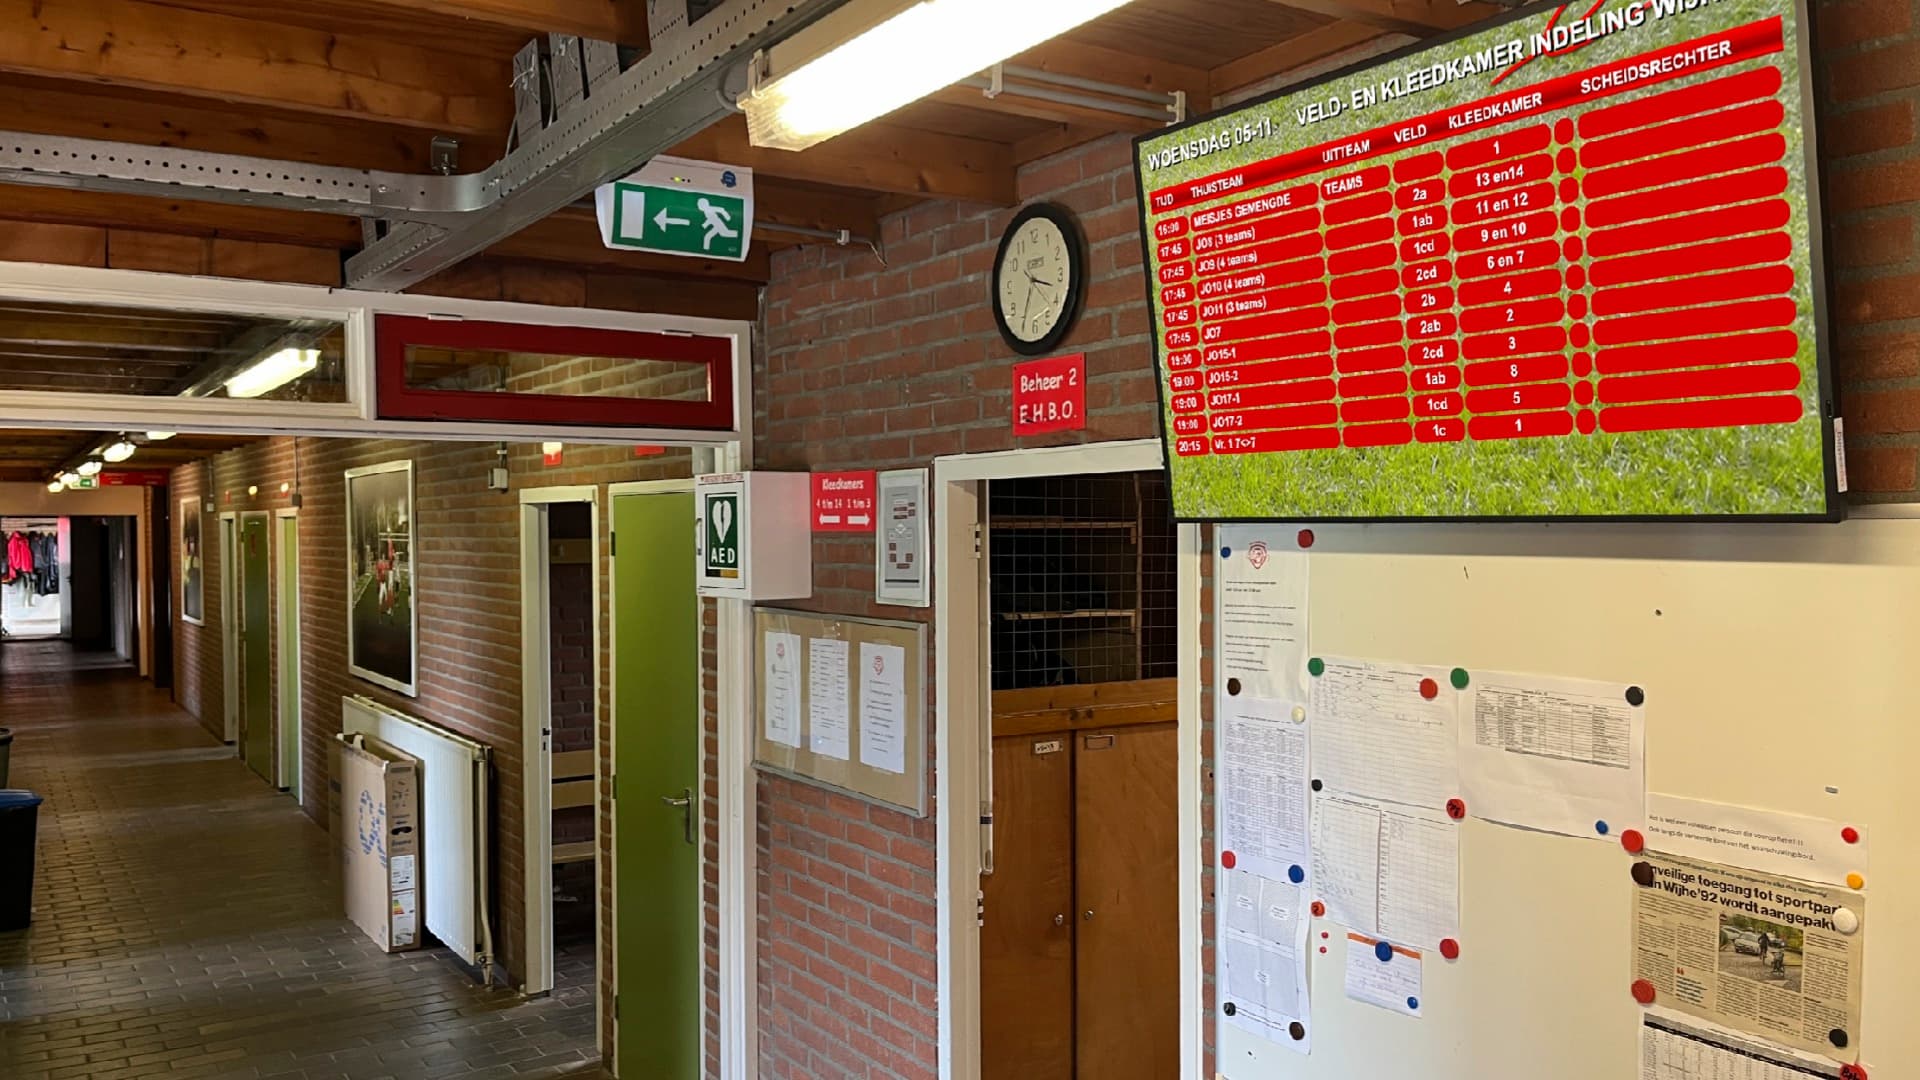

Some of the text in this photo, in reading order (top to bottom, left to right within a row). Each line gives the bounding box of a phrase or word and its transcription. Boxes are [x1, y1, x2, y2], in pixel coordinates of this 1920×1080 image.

[1580, 40, 1733, 94] SCHEIDSRECHTER
[1148, 131, 1231, 170] WOENSDAG
[1296, 97, 1349, 126] VELD-
[1351, 87, 1377, 111] EN
[1381, 39, 1524, 101] KLEEDKAMER
[1530, 3, 1646, 57] INDELING
[1448, 92, 1543, 129] KLEEDKAMER
[1393, 124, 1427, 143] VELD
[1321, 139, 1371, 164] UITTEAM
[1493, 141, 1500, 155] 1
[1190, 174, 1244, 198] THUISTEAM
[1324, 175, 1363, 195] TEAMS
[1476, 172, 1490, 187] 13
[1413, 188, 1427, 201] 2a
[1194, 193, 1291, 227] MEISJES GEMENGDE
[1475, 192, 1529, 215] 11 en 12
[1412, 213, 1433, 228] 1ab
[1030, 228, 1039, 243] 12
[1045, 233, 1050, 246] 1
[1225, 226, 1255, 243] teams)
[1481, 222, 1527, 242] 9 en 10
[1017, 240, 1025, 254] 11
[1055, 246, 1061, 261] 2
[1414, 239, 1435, 255] 1cd
[1227, 250, 1258, 265] teams)
[1487, 250, 1525, 269] 6 en 7
[1058, 267, 1063, 282] 3
[1416, 265, 1437, 282] 2cd
[1200, 280, 1222, 295] JO10
[1234, 272, 1265, 288] teams)
[1504, 281, 1512, 294] 4
[1202, 303, 1223, 318] JO11
[1235, 295, 1267, 312] teams)
[1421, 294, 1436, 307] 2b
[1506, 308, 1515, 322] 2
[1032, 320, 1038, 334] 6
[1204, 326, 1222, 340] JO7
[1420, 320, 1441, 334] 2ab
[1508, 336, 1516, 350] 3
[1206, 347, 1237, 361] JO15-1
[1423, 345, 1444, 359] 2cd
[1208, 370, 1239, 384] JO15-2
[1510, 364, 1518, 377] 8
[1021, 367, 1077, 393] Beheer 2
[1425, 372, 1446, 385] 1ab
[1210, 392, 1240, 406] JO17-1
[1427, 397, 1448, 411] 1cd
[1513, 391, 1521, 404] 5
[1212, 415, 1243, 428] JO17-2
[1515, 418, 1522, 432] 1
[1432, 424, 1446, 436] 1c
[1178, 441, 1201, 453] 20:15
[816, 498, 820, 508] 4
[834, 498, 842, 509] 14
[866, 498, 871, 509] 3
[711, 548, 735, 564] AED
[1649, 865, 1696, 884] nveilige
[1698, 874, 1751, 898] toegang
[1753, 887, 1773, 902] tot
[1775, 893, 1841, 916] sportpar
[1719, 896, 1759, 914] wordt
